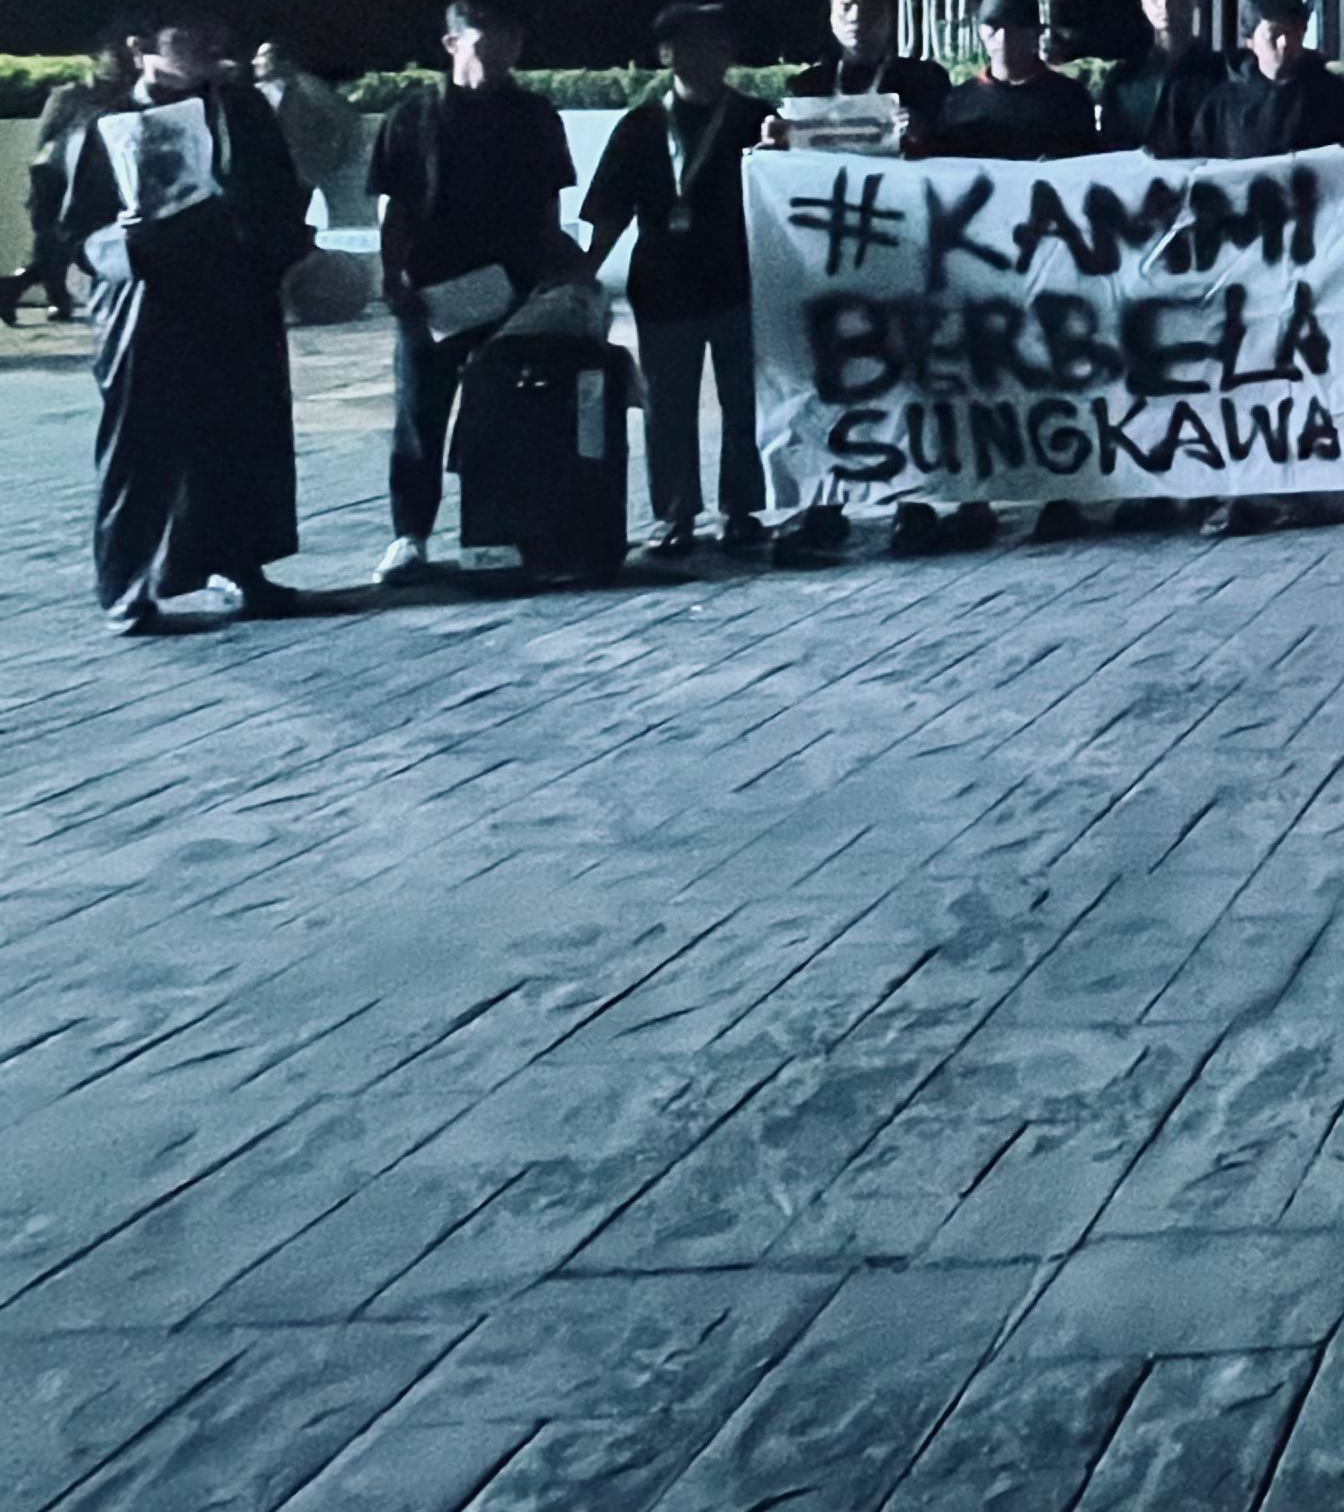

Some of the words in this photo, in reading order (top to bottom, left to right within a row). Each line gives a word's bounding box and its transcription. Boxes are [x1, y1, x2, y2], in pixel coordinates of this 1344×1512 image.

[789, 165, 1320, 292] #KAMMI
[800, 279, 1331, 406] BERBELA
[826, 395, 1342, 483] SUNGKAWA
